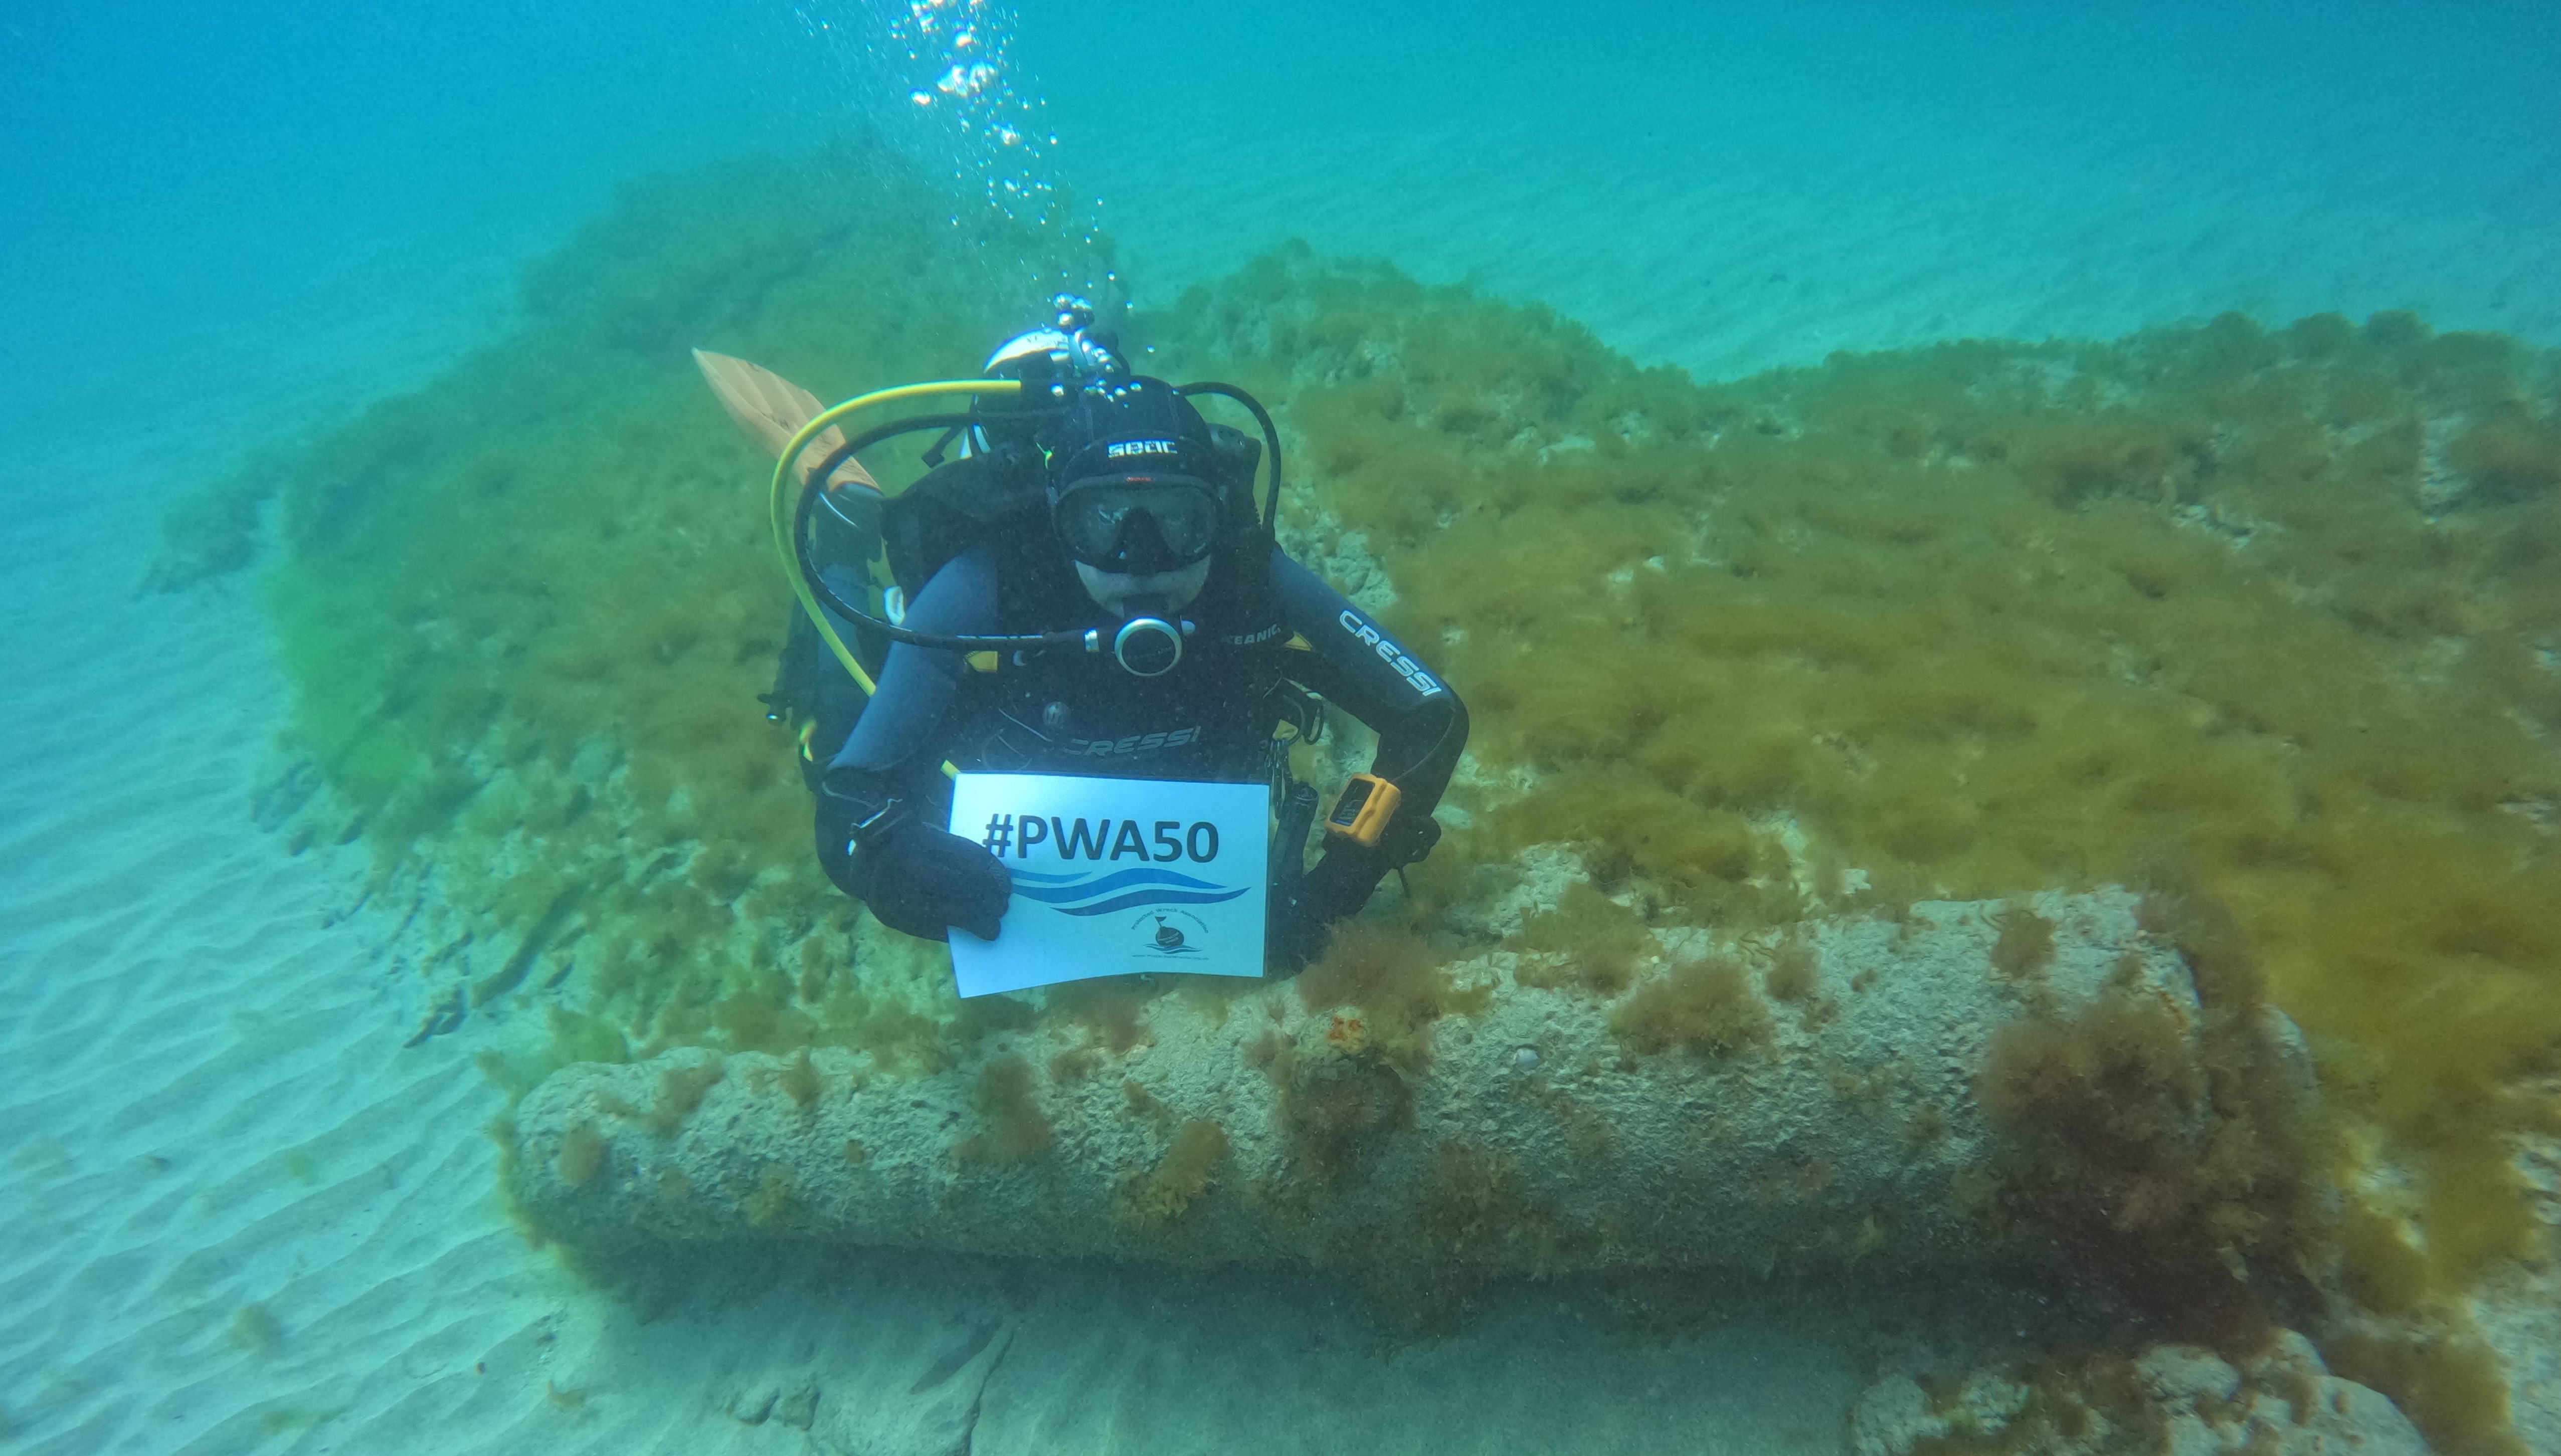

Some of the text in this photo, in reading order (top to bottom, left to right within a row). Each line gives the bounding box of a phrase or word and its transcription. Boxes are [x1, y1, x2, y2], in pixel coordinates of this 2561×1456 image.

[1340, 610, 1442, 697] CRESSI
[983, 814, 1219, 863] #PWA50
[1131, 910, 1154, 930] Protected
[1180, 910, 1209, 933] Association
